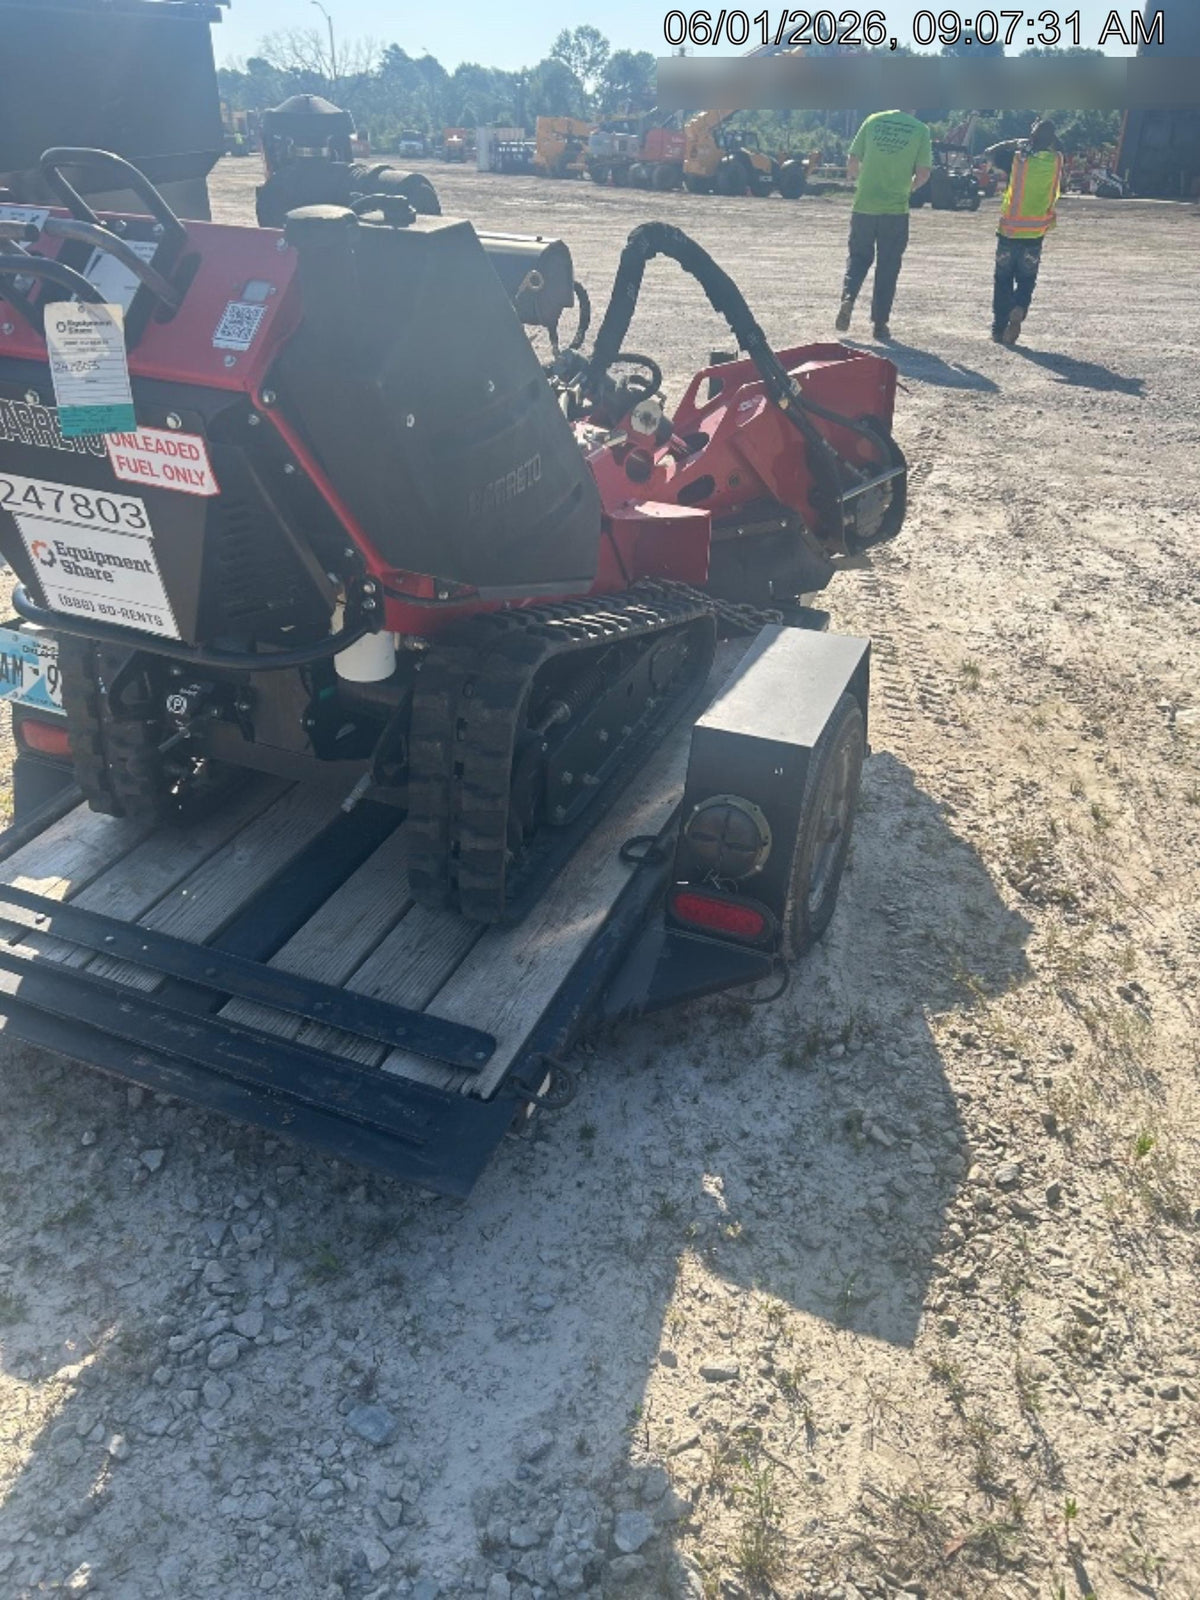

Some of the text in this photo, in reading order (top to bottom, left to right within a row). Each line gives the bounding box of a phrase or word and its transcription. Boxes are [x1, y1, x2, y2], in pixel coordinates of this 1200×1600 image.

[109, 431, 200, 461] UNLEADED
[116, 455, 205, 487] FUEL ONLY
[0, 479, 146, 529] 247803
[52, 540, 155, 574] Equipment
[60, 559, 114, 583] Share
